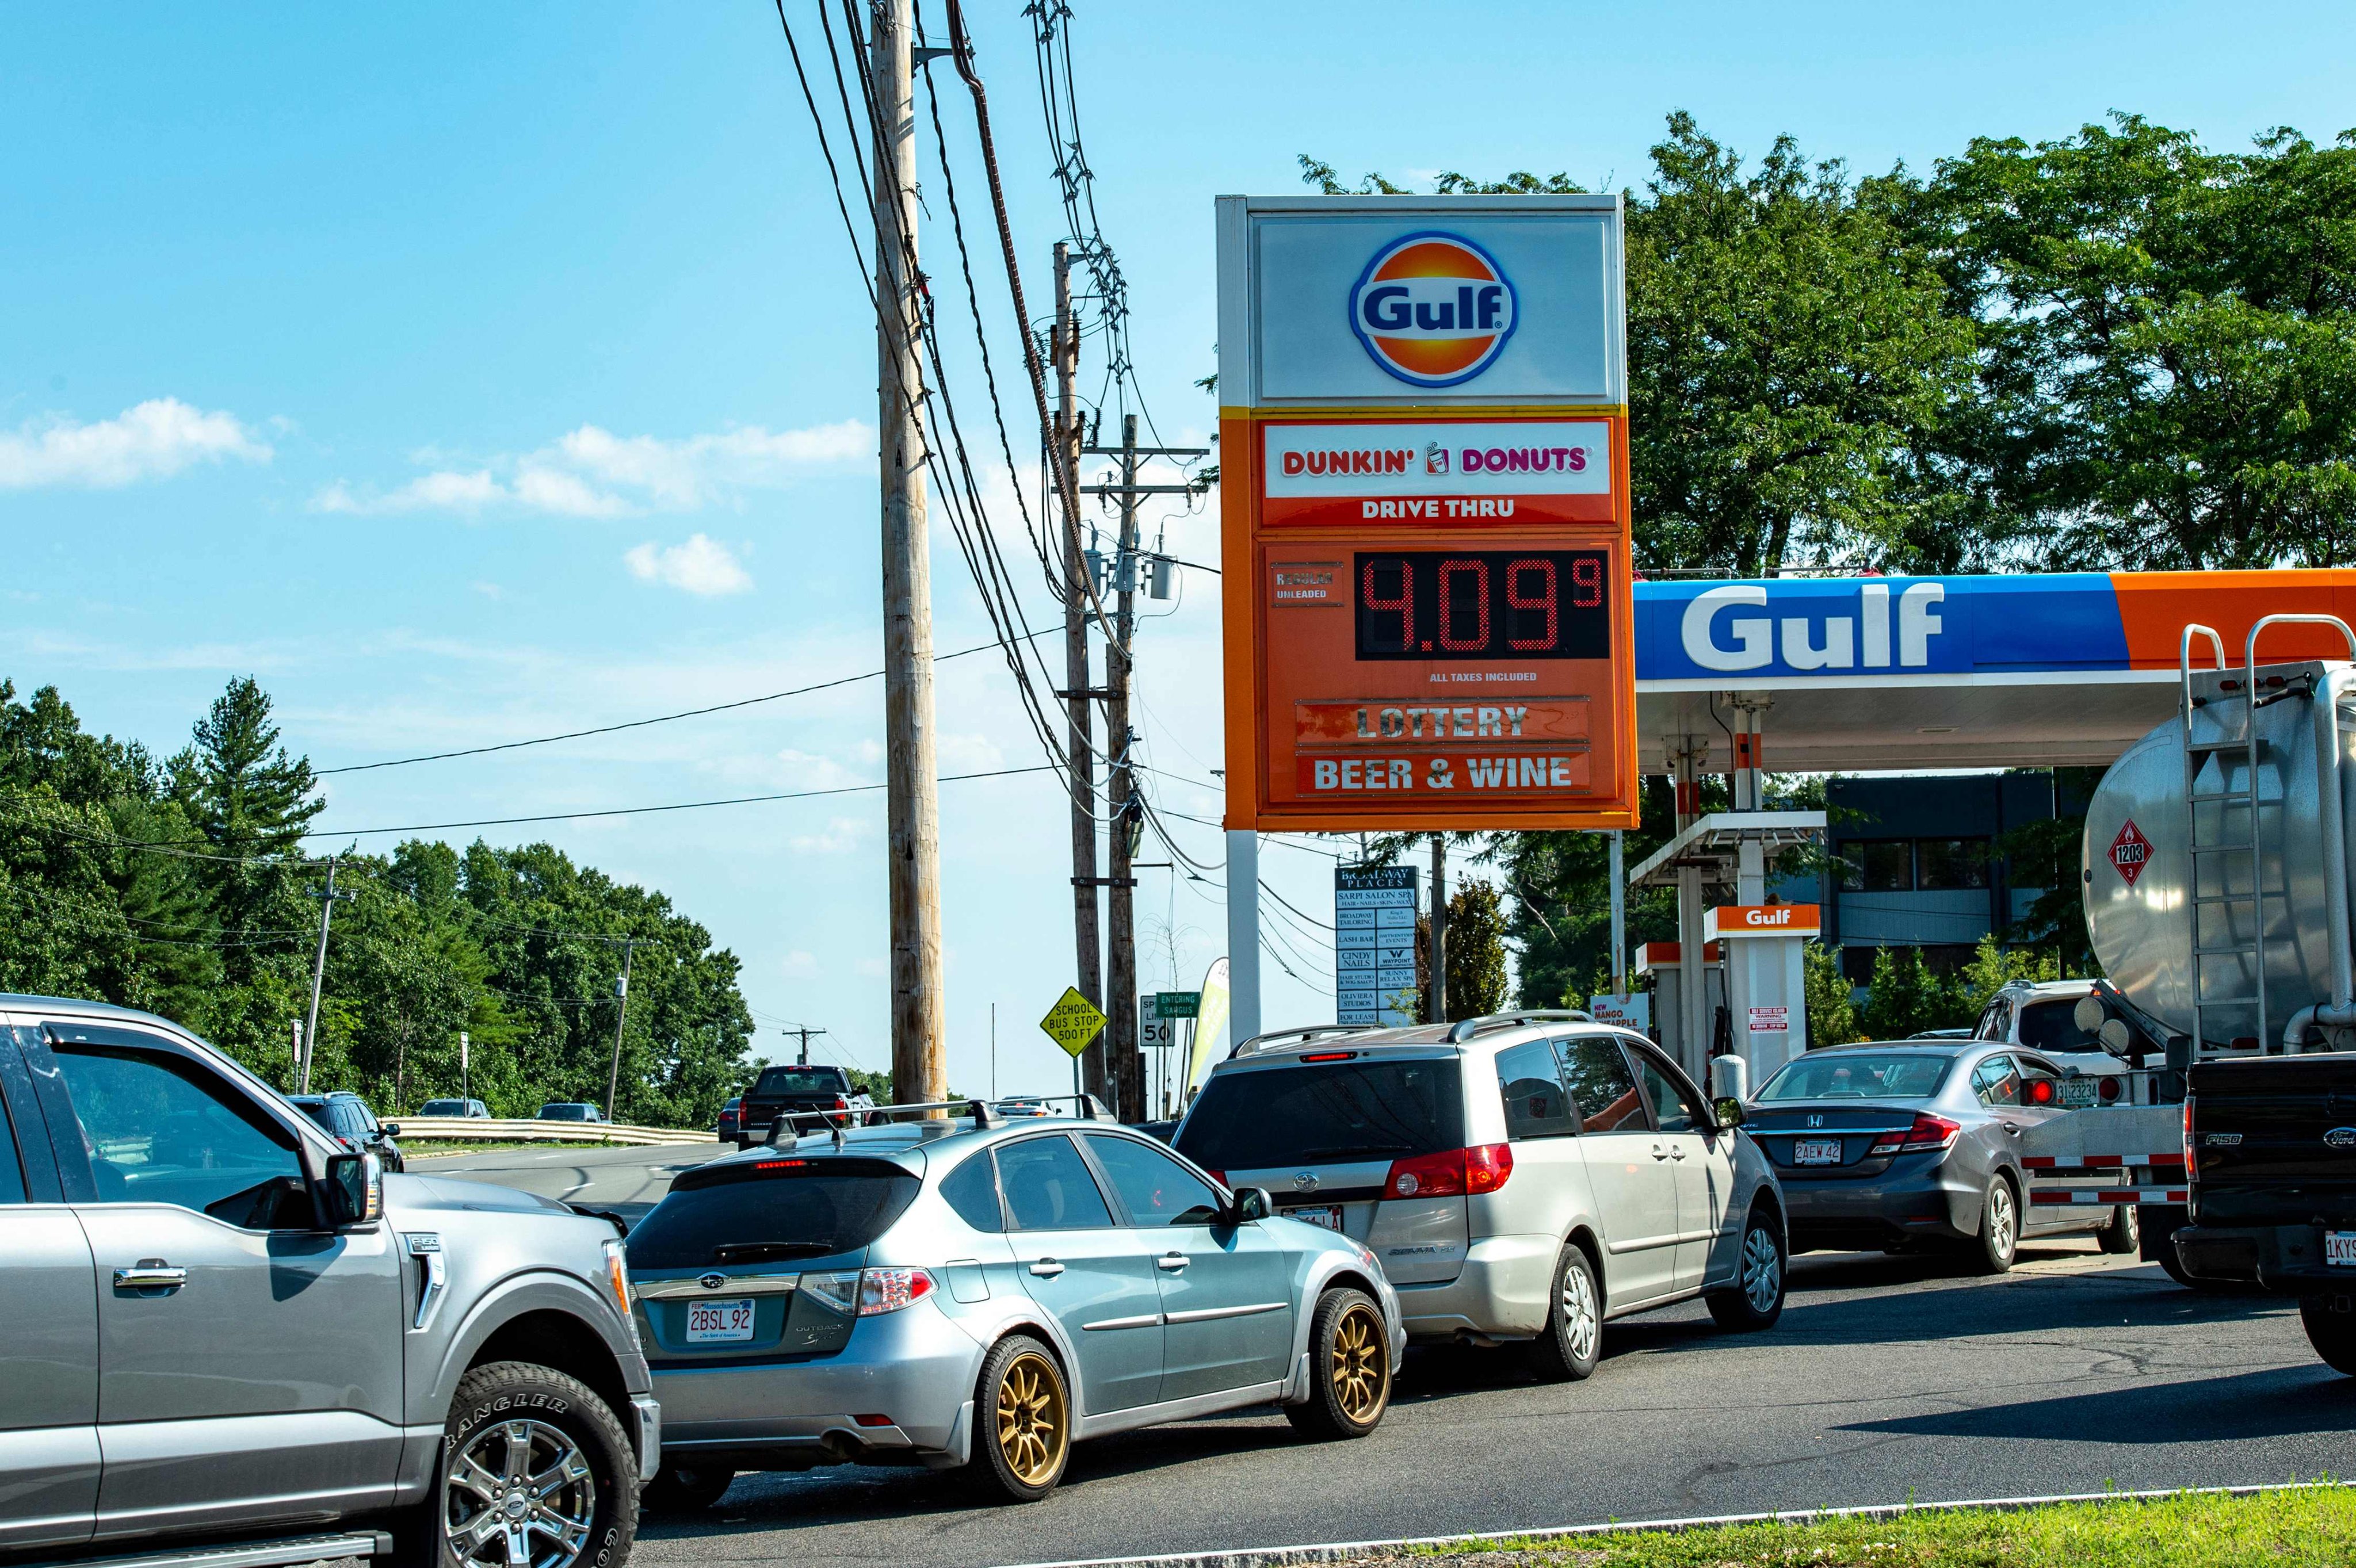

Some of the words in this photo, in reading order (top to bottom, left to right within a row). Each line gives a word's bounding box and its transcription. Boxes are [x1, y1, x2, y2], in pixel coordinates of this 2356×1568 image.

[1363, 286, 1503, 330] Gulf
[1284, 449, 1415, 475] DUNKIN'
[1463, 448, 1587, 474] DONUTS
[1362, 500, 1439, 519] DRIVE
[1444, 499, 1514, 518] THRU
[1277, 572, 1332, 585] REGULAR
[1277, 590, 1327, 599] UNLEADED
[1681, 582, 1945, 671] Gulf
[1430, 673, 1449, 683] ALL
[1450, 673, 1483, 683] TAXES
[1486, 672, 1537, 682] INCLUDED
[1357, 706, 1528, 738] LOTTERY
[1314, 759, 1413, 790] BEER
[1427, 758, 1454, 789] &
[1468, 757, 1572, 787] WINE
[2117, 844, 2143, 862] 1203
[2128, 868, 2133, 878] 3
[1347, 879, 1403, 888] PLACES
[1746, 909, 1791, 925] Gulf
[1161, 995, 1195, 1004] ENTERING
[1056, 1003, 1093, 1016] SCHOOL
[1595, 1009, 1624, 1019] MANGO
[1049, 1018, 1068, 1029] BUS
[1074, 1015, 1099, 1027] STOP
[1059, 1029, 1078, 1041] 500
[1079, 1028, 1092, 1039] FT
[1144, 1024, 1170, 1041] 50
[2206, 1134, 2243, 1145] F-150
[2331, 1131, 2355, 1145] Ford
[1796, 1146, 1823, 1158] 2AEW
[1826, 1145, 1839, 1158] 42
[1388, 1246, 1437, 1256] SIENNA
[702, 1302, 739, 1310] Massachusetts
[690, 1310, 727, 1331] 2BSL
[731, 1309, 750, 1329] 92
[796, 1324, 845, 1332] OUTBACK
[446, 1393, 569, 1455] RANGLER
